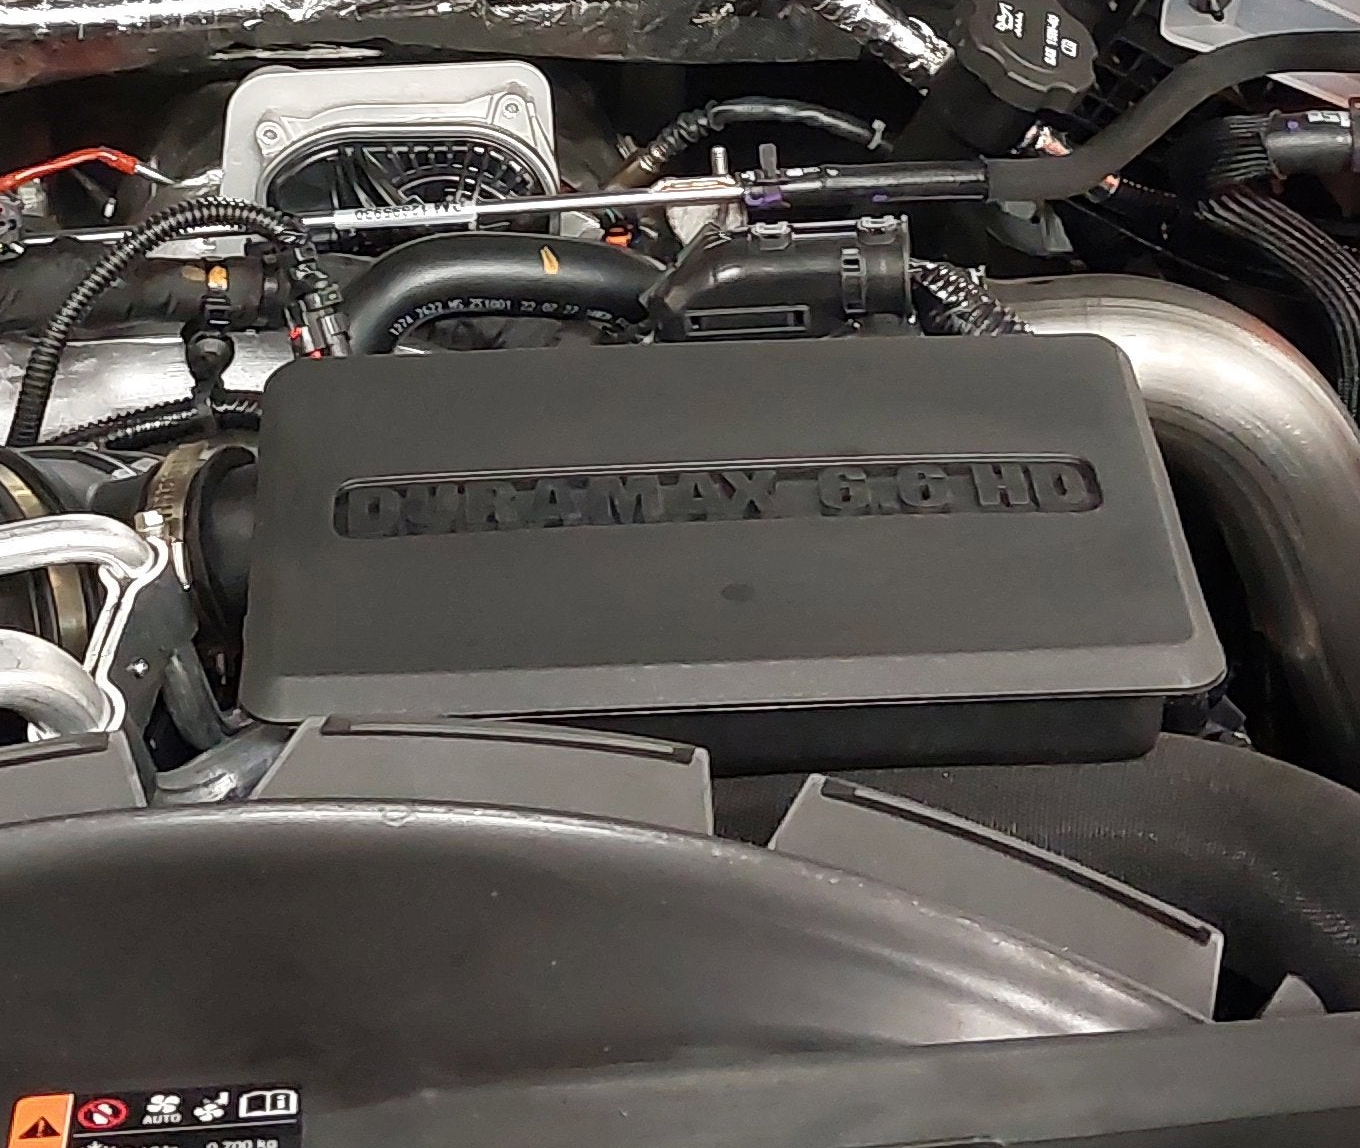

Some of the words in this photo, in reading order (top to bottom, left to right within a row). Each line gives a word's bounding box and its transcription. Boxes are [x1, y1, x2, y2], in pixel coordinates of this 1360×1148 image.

[347, 469, 777, 538] DURAMAX
[818, 463, 946, 515] 6.6
[973, 458, 1091, 511] HD
[142, 1113, 183, 1126] AUTO
